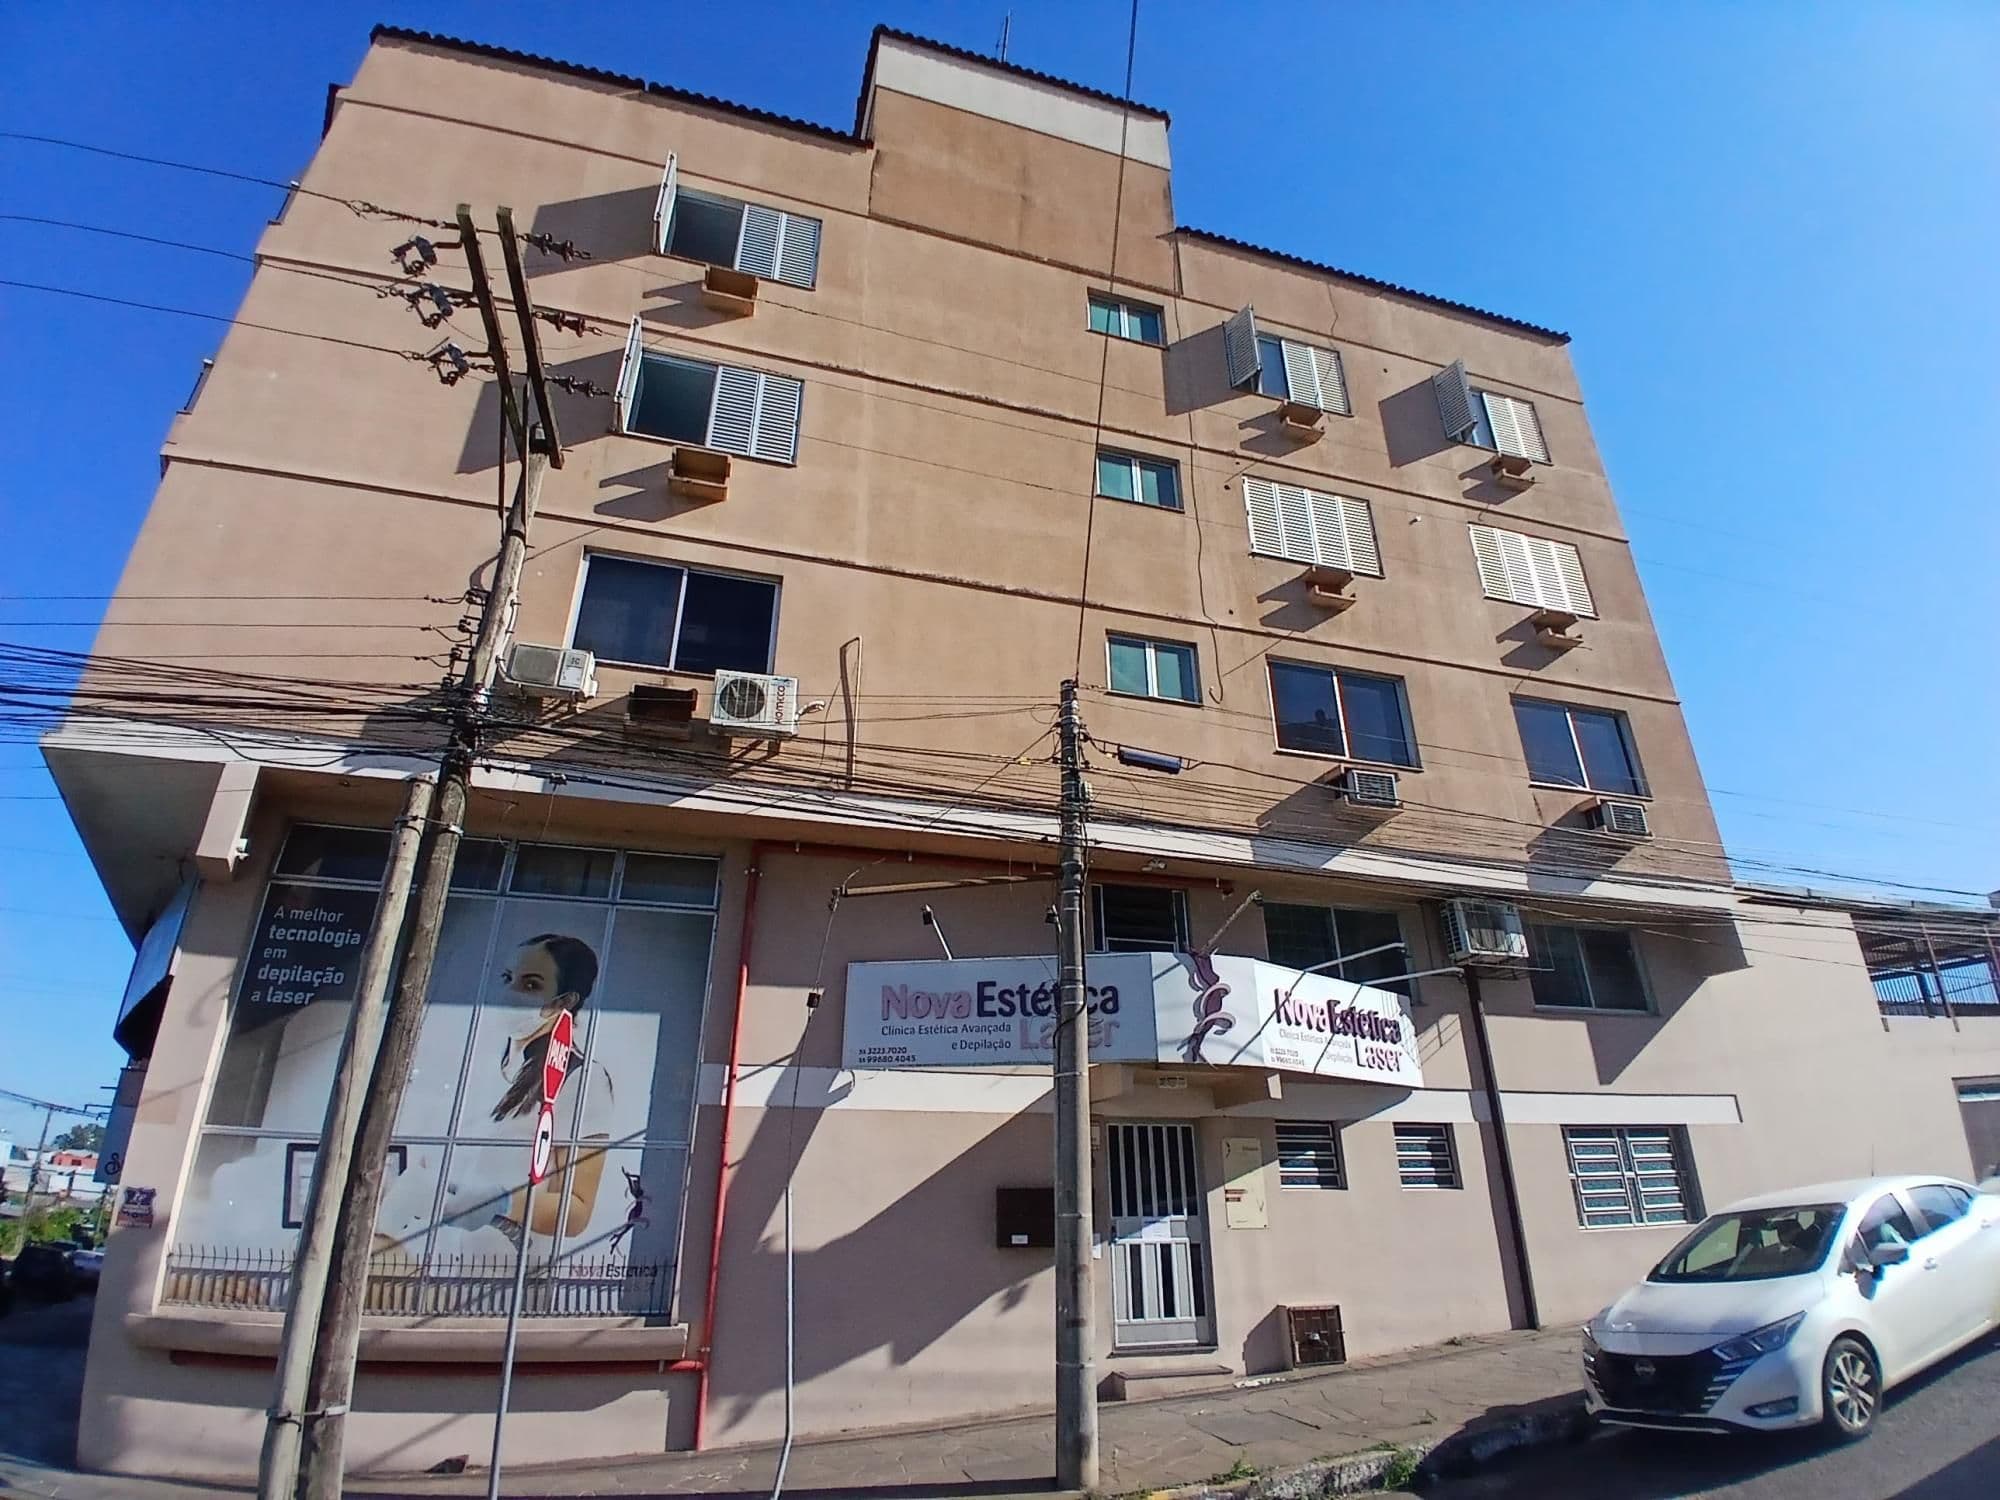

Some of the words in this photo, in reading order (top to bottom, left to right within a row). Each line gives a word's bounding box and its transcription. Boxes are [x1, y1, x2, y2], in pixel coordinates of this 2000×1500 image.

[273, 905, 285, 919] A
[289, 908, 344, 923] melhor
[268, 924, 361, 948] tecnologia
[263, 947, 288, 959] em
[257, 963, 345, 987] depilação
[250, 991, 261, 1002] a
[266, 985, 315, 1005] laser
[881, 1025, 916, 1036] Clínica
[918, 1024, 958, 1035] Estética
[961, 1022, 1012, 1035] Avançada
[1019, 1018, 1120, 1050] Laer
[548, 1036, 570, 1073] PARE
[951, 1042, 958, 1051] e
[959, 1039, 1012, 1051] Depilação
[1354, 1038, 1402, 1073] Laser
